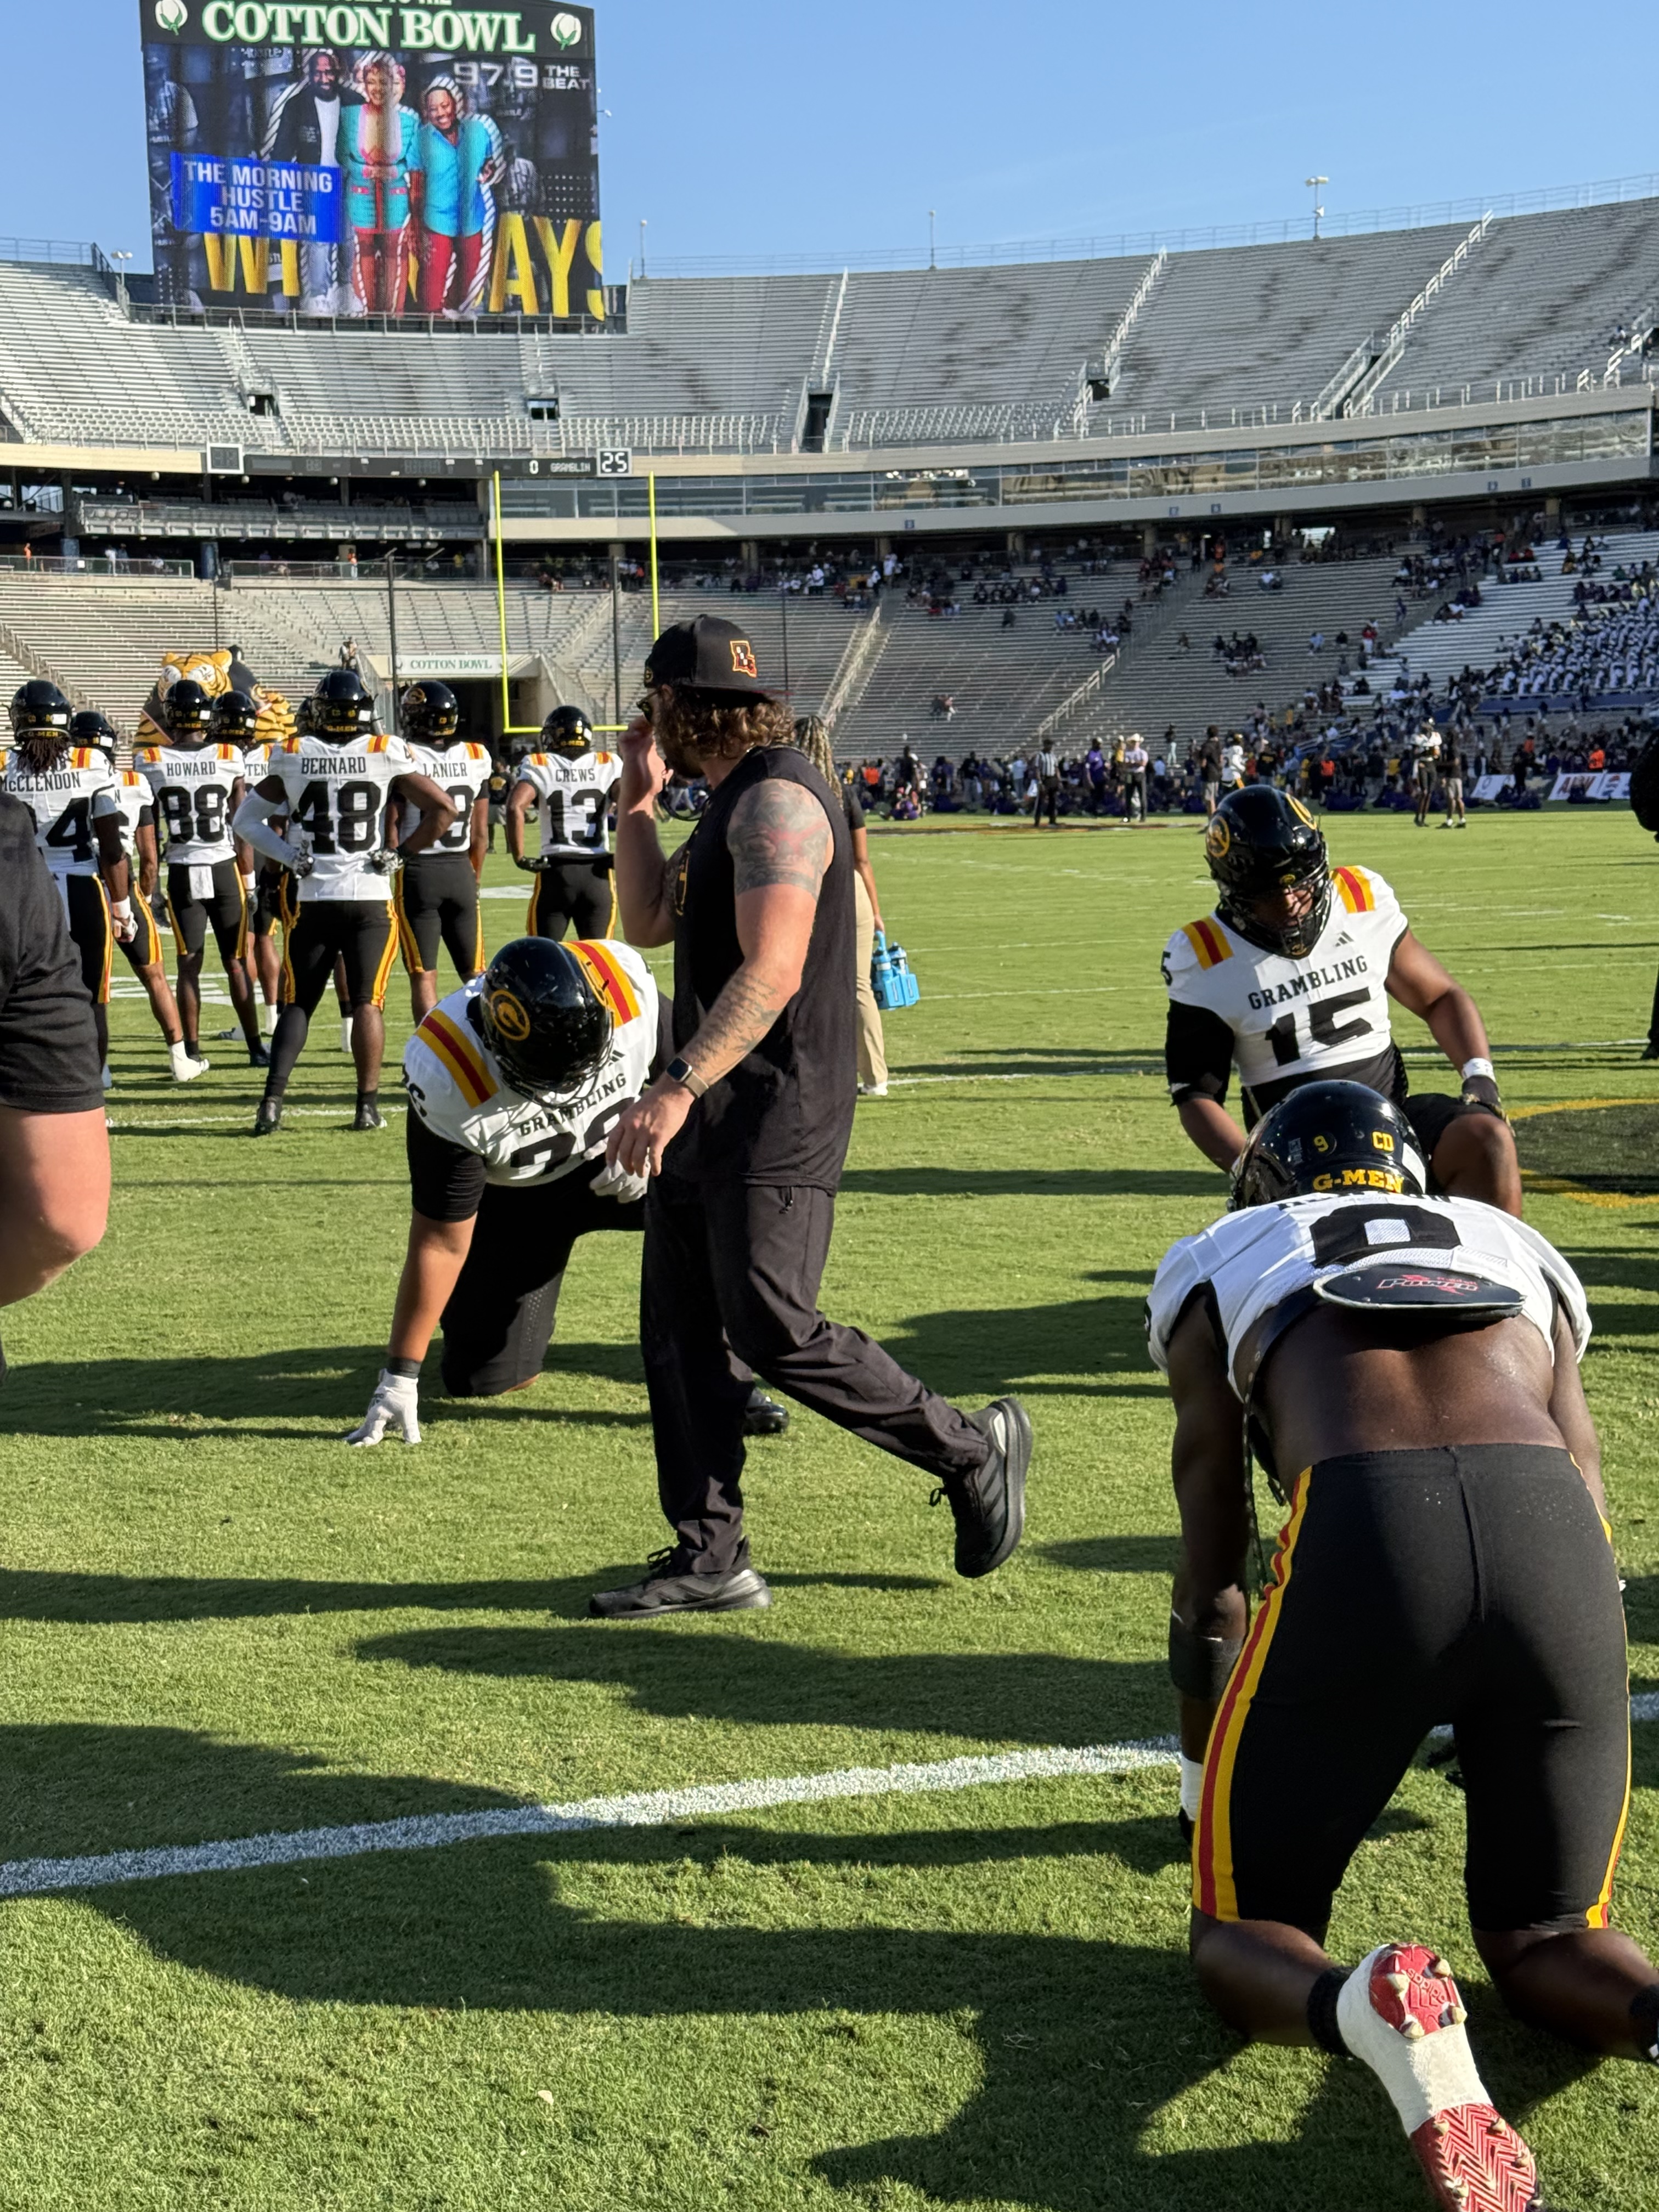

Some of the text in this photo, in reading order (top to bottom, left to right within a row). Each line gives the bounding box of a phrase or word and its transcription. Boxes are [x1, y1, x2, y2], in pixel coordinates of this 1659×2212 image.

[202, 1, 536, 52] COTTON BOWL
[543, 78, 590, 89] BEAT
[545, 65, 580, 77] THE
[184, 161, 333, 193] THE MORNING
[221, 186, 304, 212] HUSTLE
[210, 206, 317, 235] 5AM-9AM
[602, 452, 627, 472] 25
[411, 660, 492, 669] COTTON BOWL
[166, 761, 216, 777] HOWARD
[302, 757, 366, 775] BERNARD
[424, 762, 468, 778] LANIER
[556, 769, 595, 782] CREWS
[158, 784, 228, 844] 88
[299, 781, 382, 854] 48
[546, 788, 606, 847] 13
[46, 797, 94, 863] 4
[1248, 955, 1367, 1011] GRAMBLING
[1266, 987, 1374, 1066] 15
[520, 1074, 627, 1137] GRAMBLING
[1313, 1131, 1395, 1152] 9 CD
[1312, 1169, 1404, 1194] G-MEN
